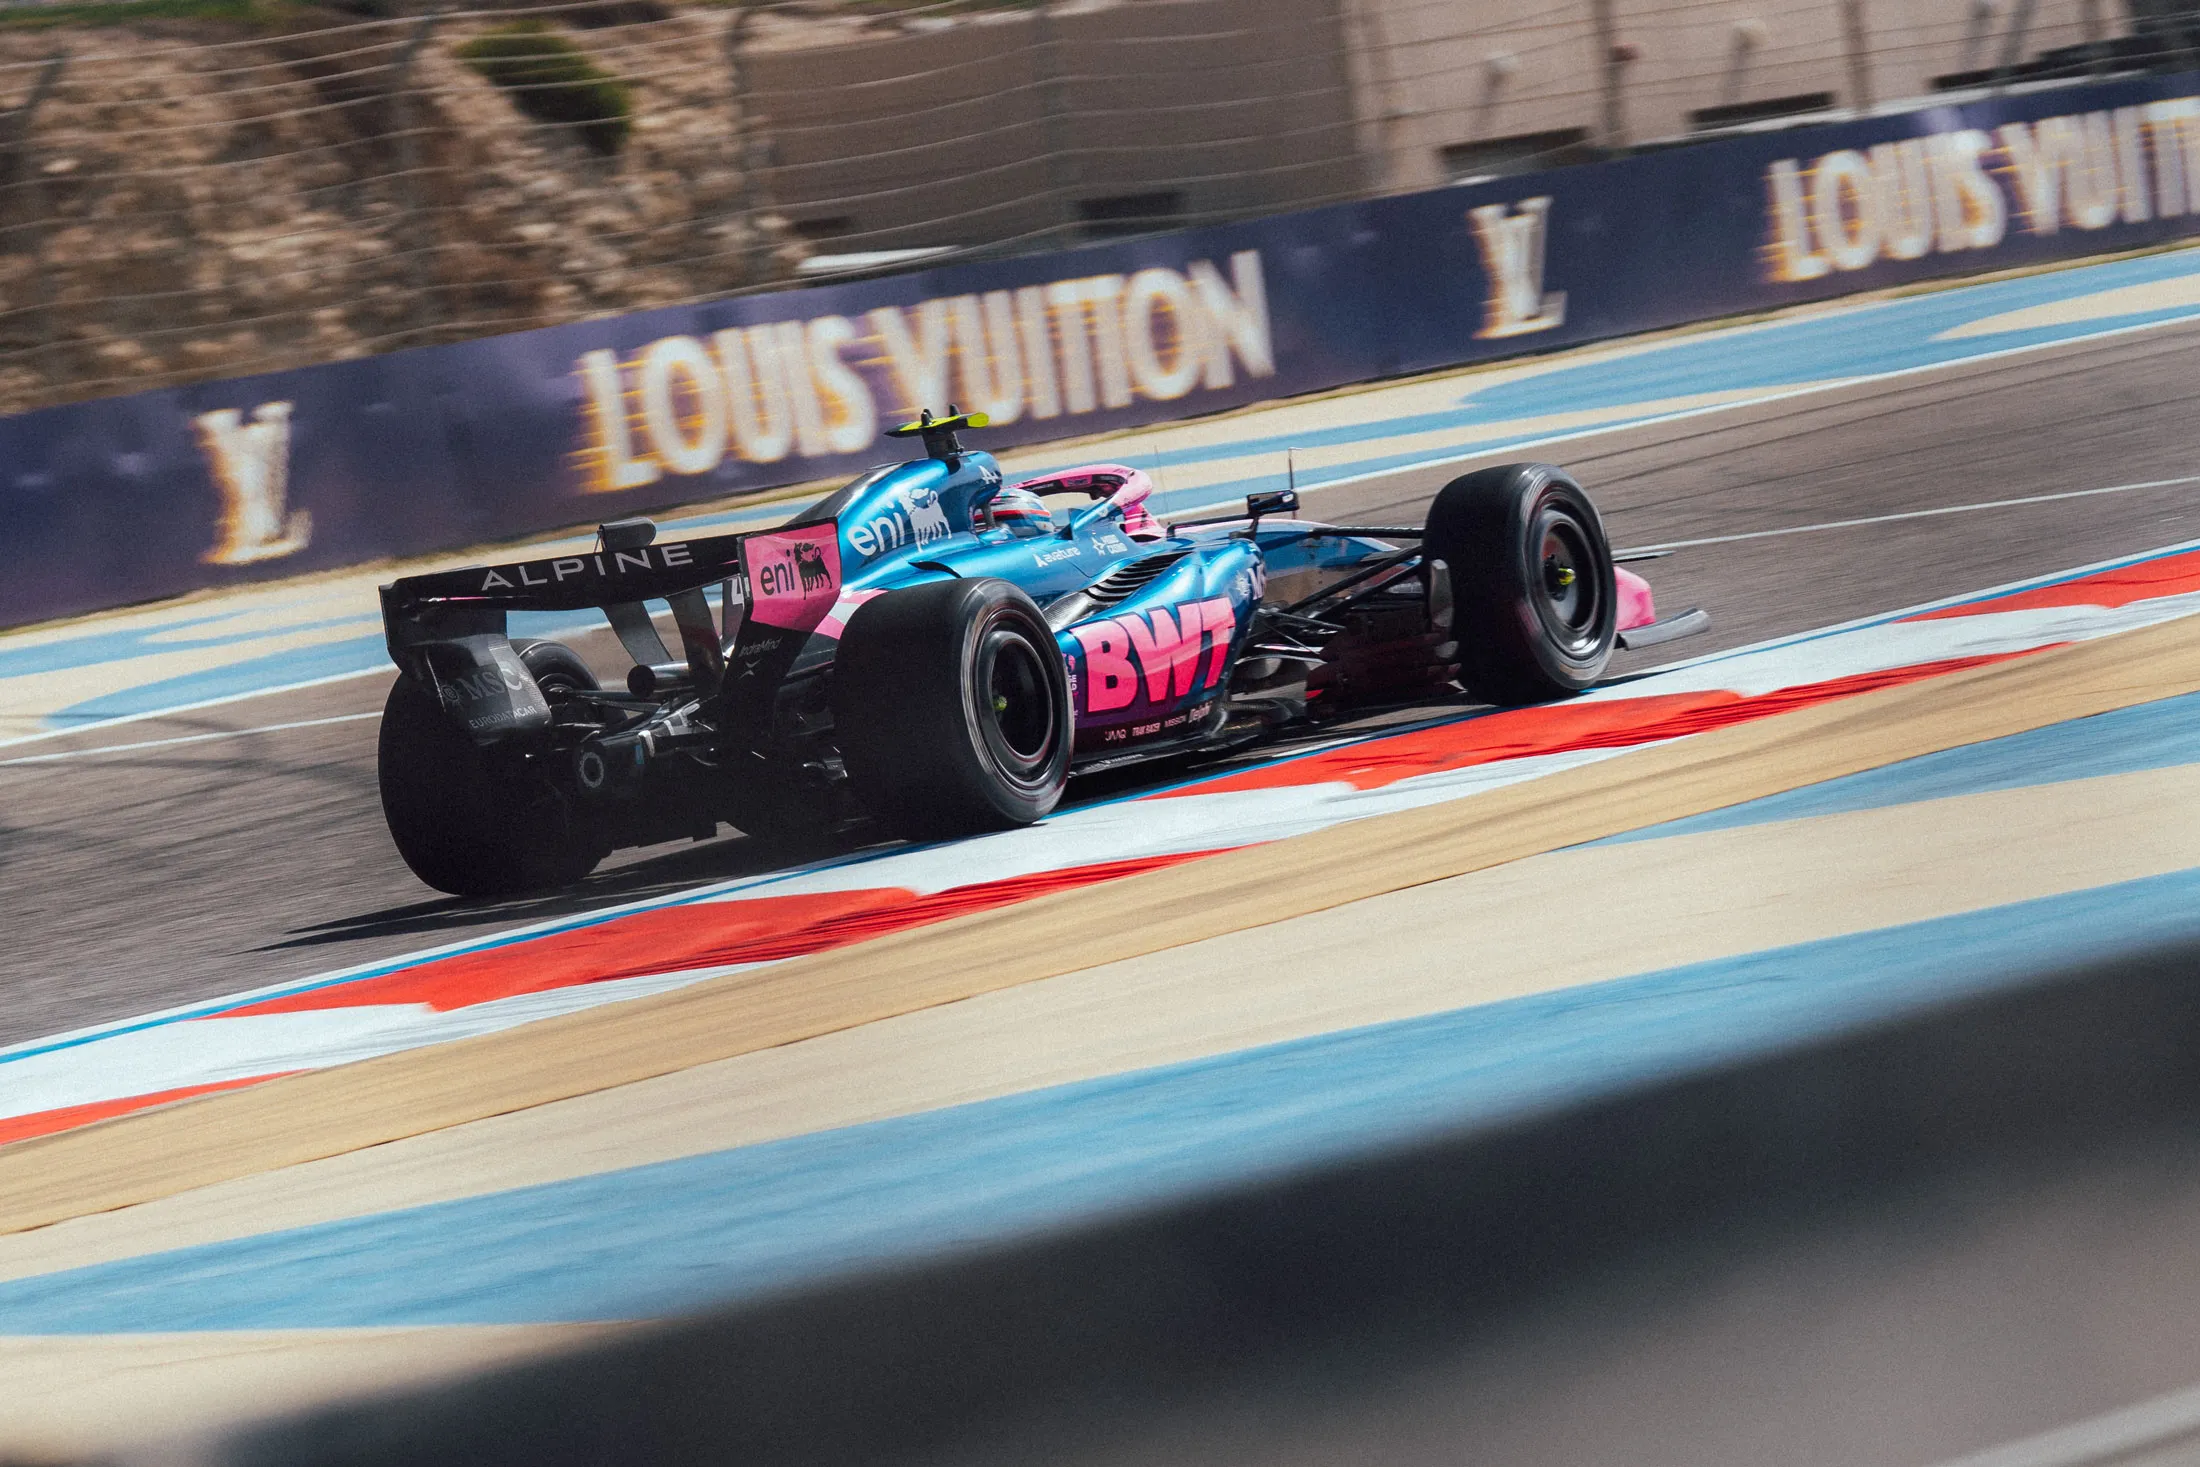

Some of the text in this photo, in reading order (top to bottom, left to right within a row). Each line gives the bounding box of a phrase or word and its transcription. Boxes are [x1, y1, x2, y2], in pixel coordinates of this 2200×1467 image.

[1768, 129, 2007, 282] LOUIS
[577, 249, 1275, 494] LOUIS VUITTON
[847, 500, 905, 556] eni
[481, 543, 693, 591] ALPINE
[760, 549, 796, 596] eni
[1068, 597, 1236, 713] BWT
[455, 662, 523, 701] MSC
[469, 705, 538, 729] EURODATACAR
